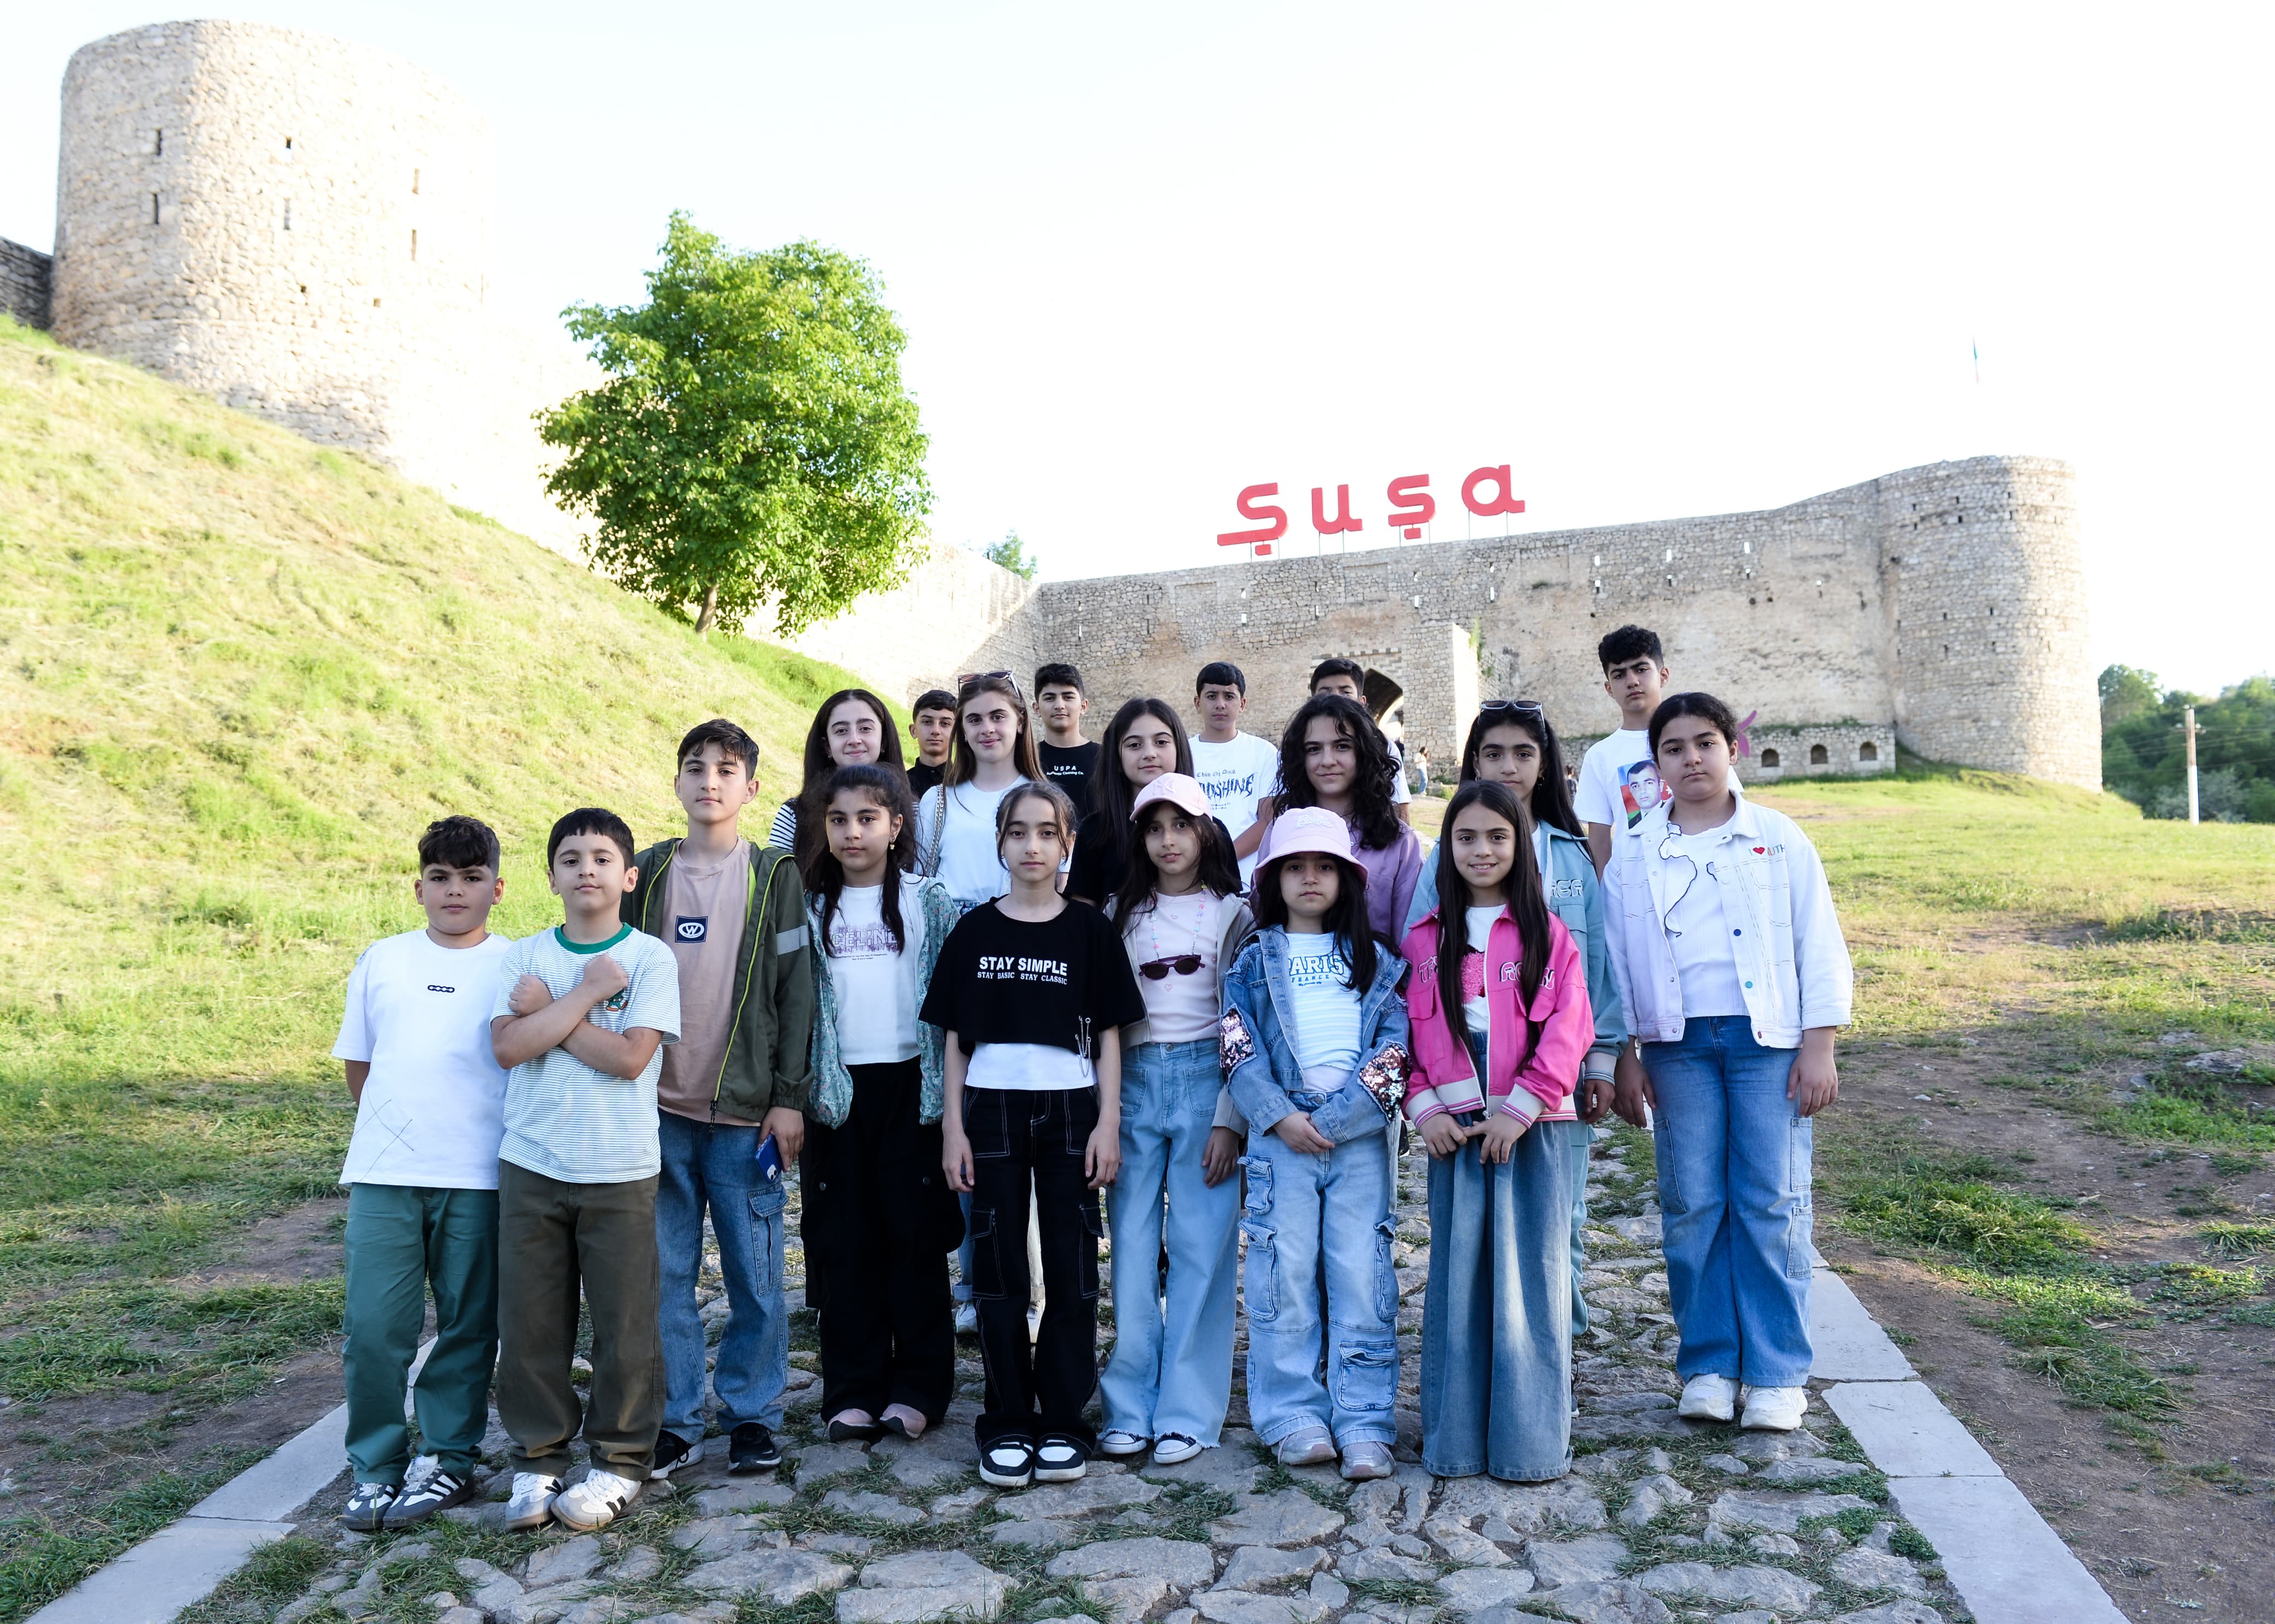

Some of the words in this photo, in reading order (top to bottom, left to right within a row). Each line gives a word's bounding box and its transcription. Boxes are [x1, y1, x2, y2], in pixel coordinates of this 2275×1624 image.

[1217, 465, 1525, 556] Şuşa
[979, 956, 1015, 971] STAY
[1017, 957, 1068, 977] SIMPLE
[1288, 954, 1344, 976] ARIS
[977, 971, 994, 979] STAY
[1041, 975, 1068, 985] CLASSIC
